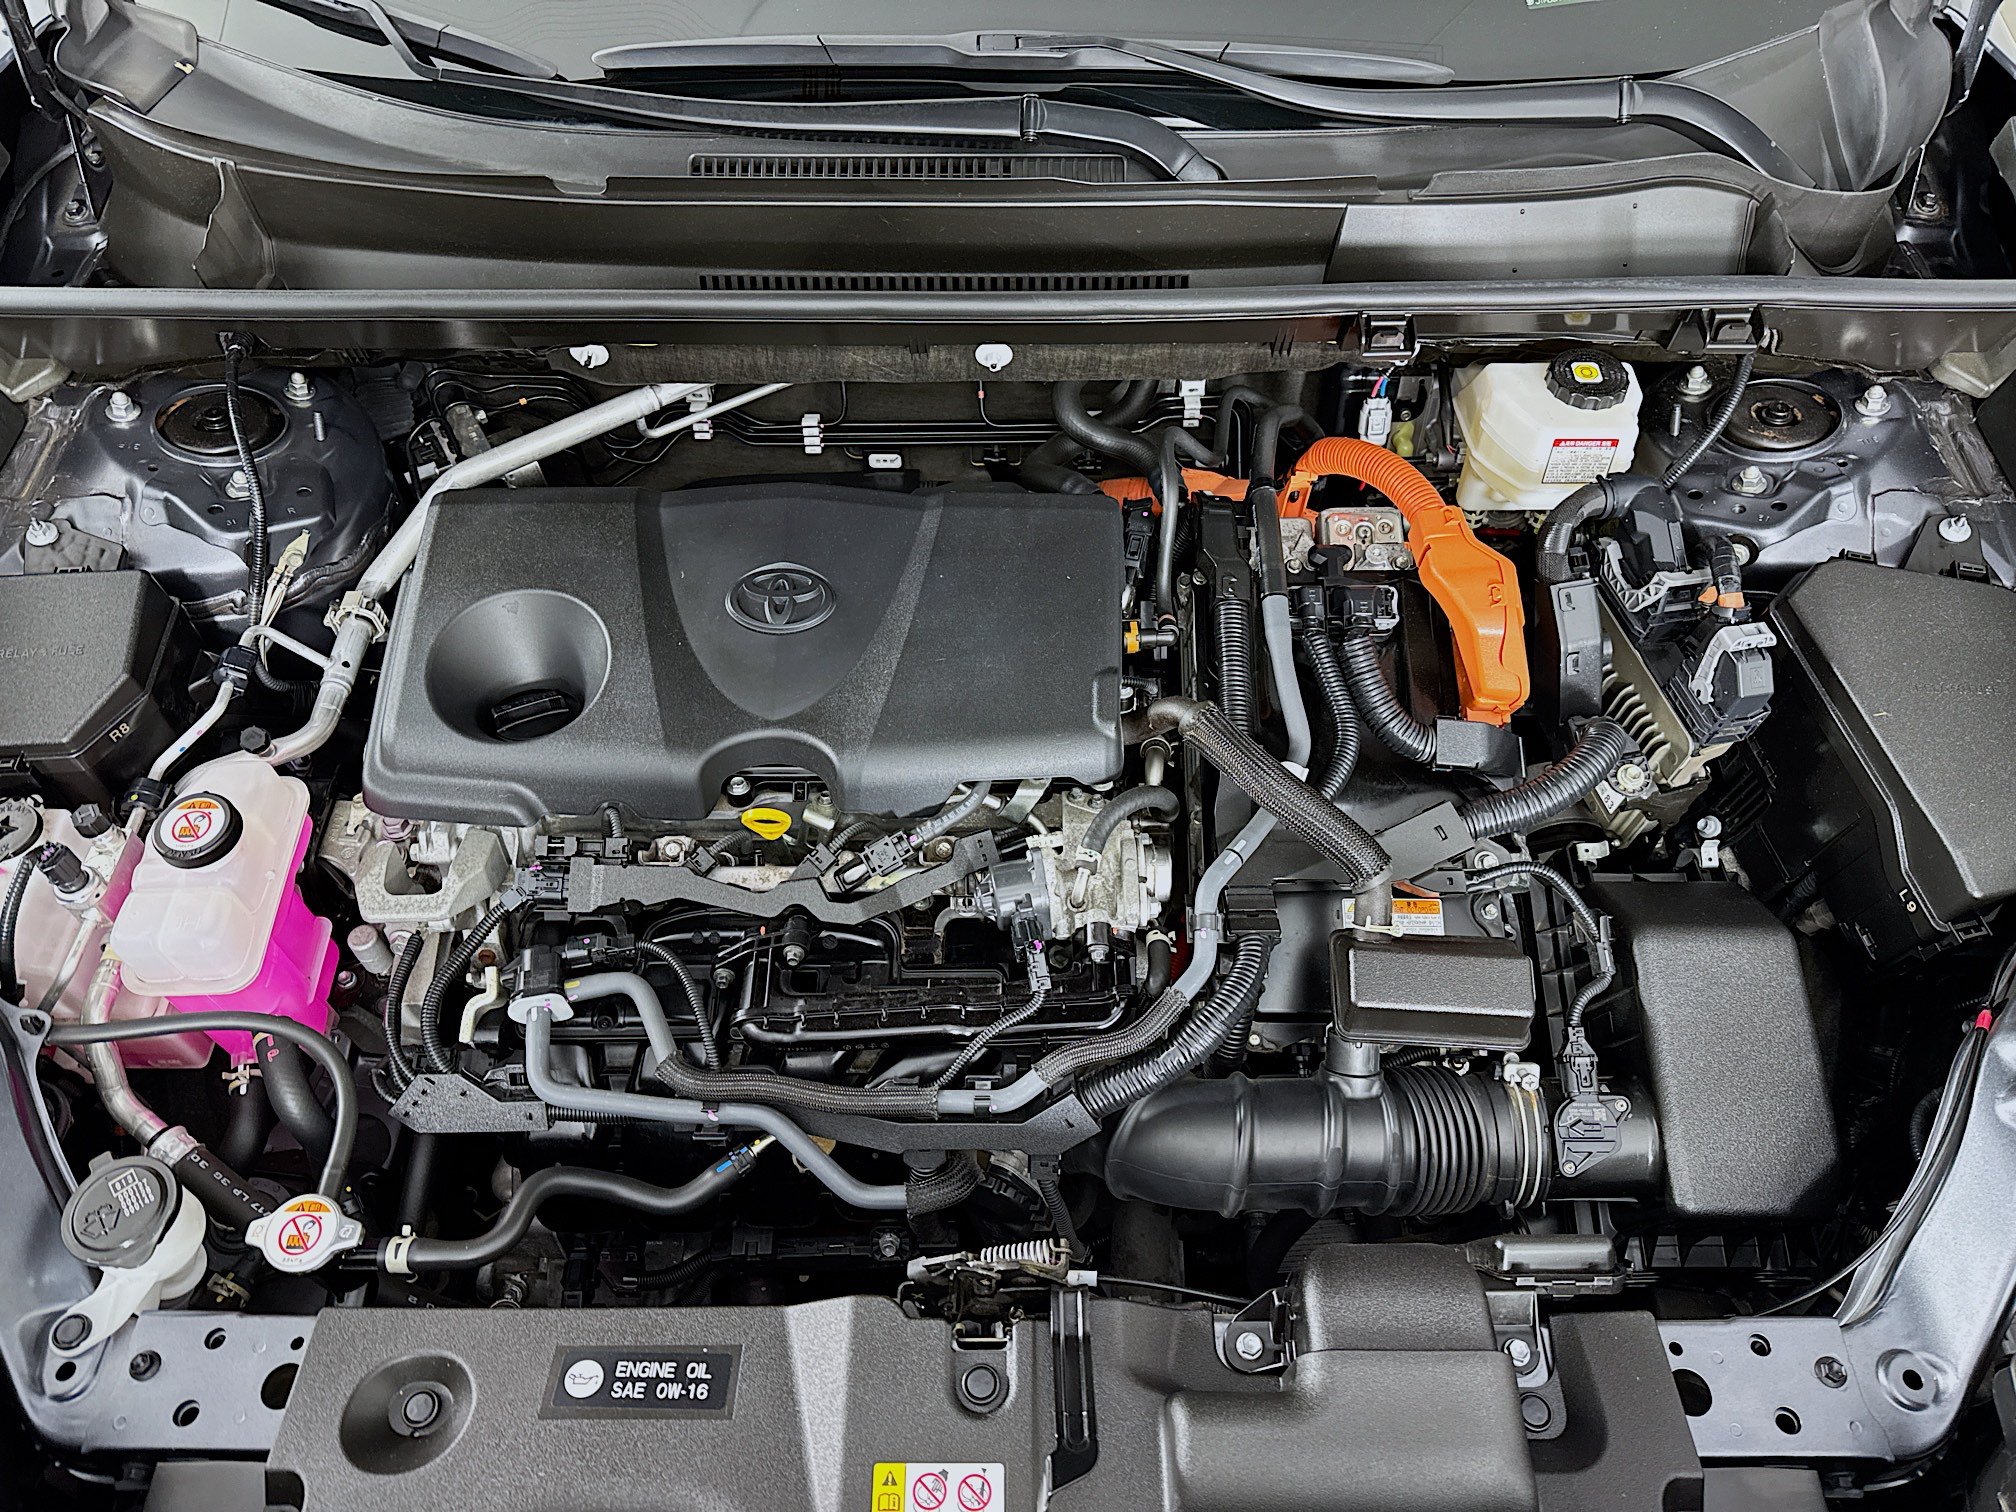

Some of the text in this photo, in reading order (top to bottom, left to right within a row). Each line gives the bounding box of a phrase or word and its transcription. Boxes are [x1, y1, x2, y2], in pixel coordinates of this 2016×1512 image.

[108, 721, 131, 743] R8
[232, 1187, 251, 1202] LP
[614, 1360, 713, 1379] ENGINE OIL
[610, 1381, 709, 1400] SAE 0W-16
